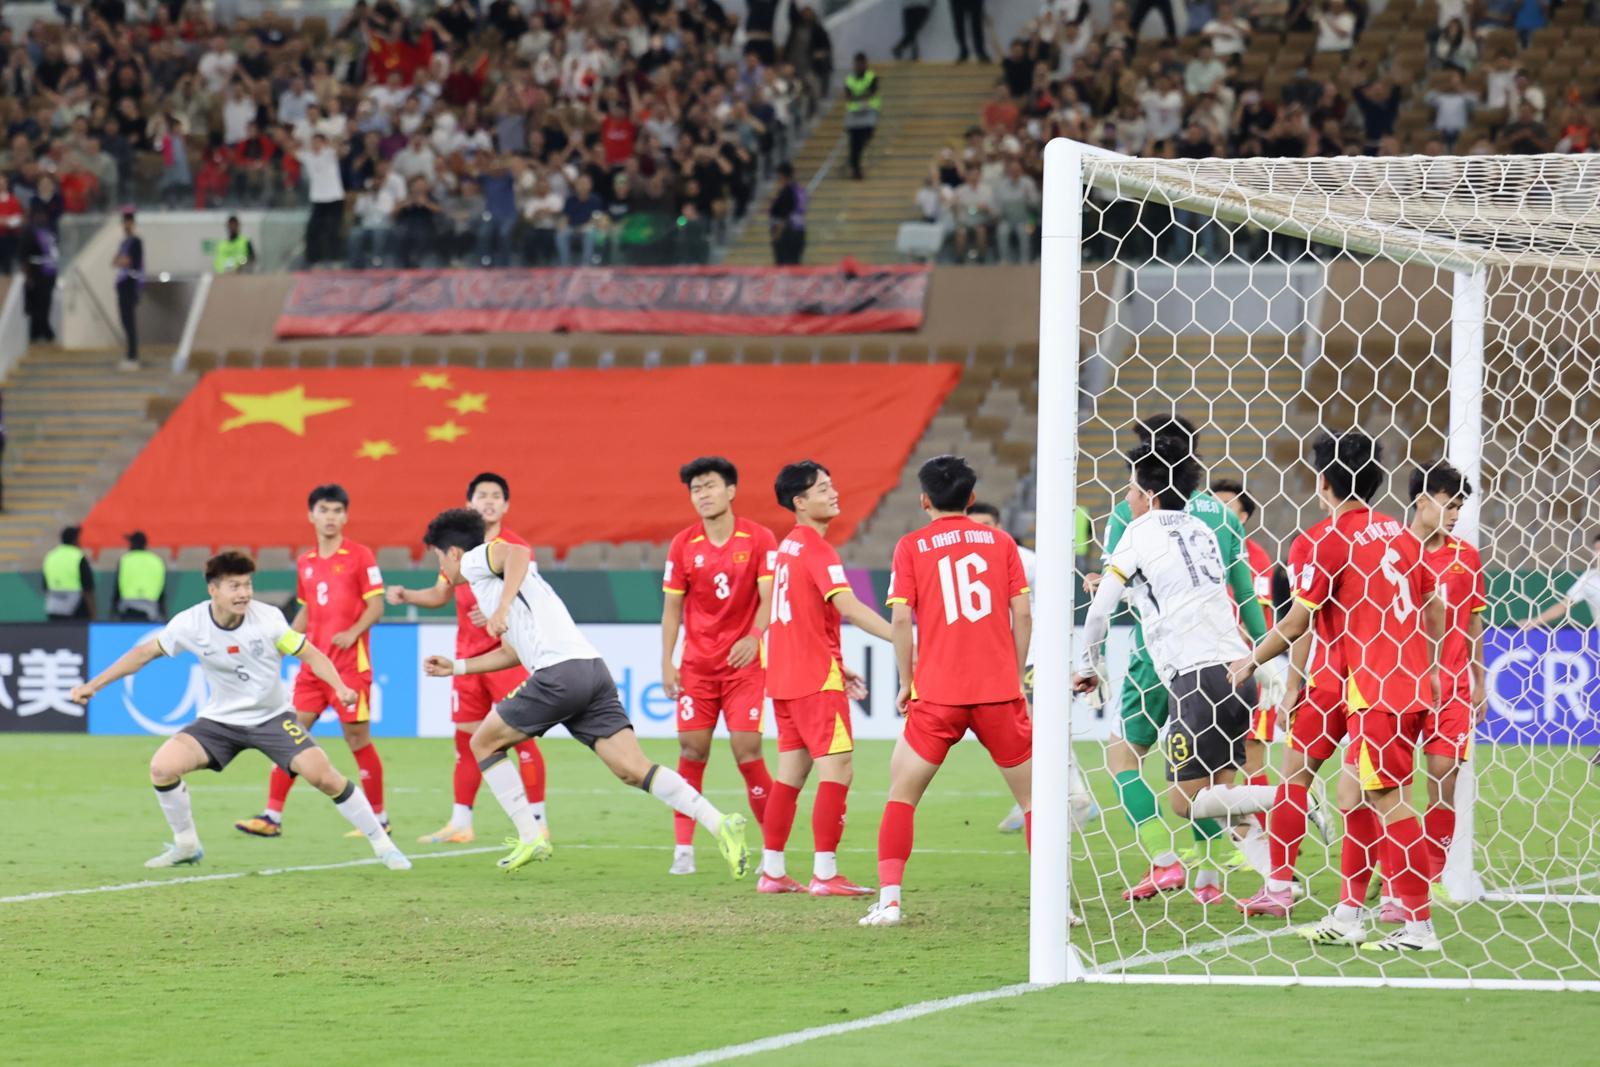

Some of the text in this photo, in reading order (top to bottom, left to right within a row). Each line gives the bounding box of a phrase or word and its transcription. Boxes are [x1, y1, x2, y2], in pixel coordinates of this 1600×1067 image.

[1168, 530, 1226, 587] 13
[713, 572, 730, 600] 3
[938, 552, 992, 625] 16
[1379, 548, 1414, 624] 5
[0, 648, 84, 717] 美
[234, 665, 250, 682] 5
[679, 695, 695, 721] 3
[282, 719, 302, 737] 5
[1167, 733, 1188, 761] 13
